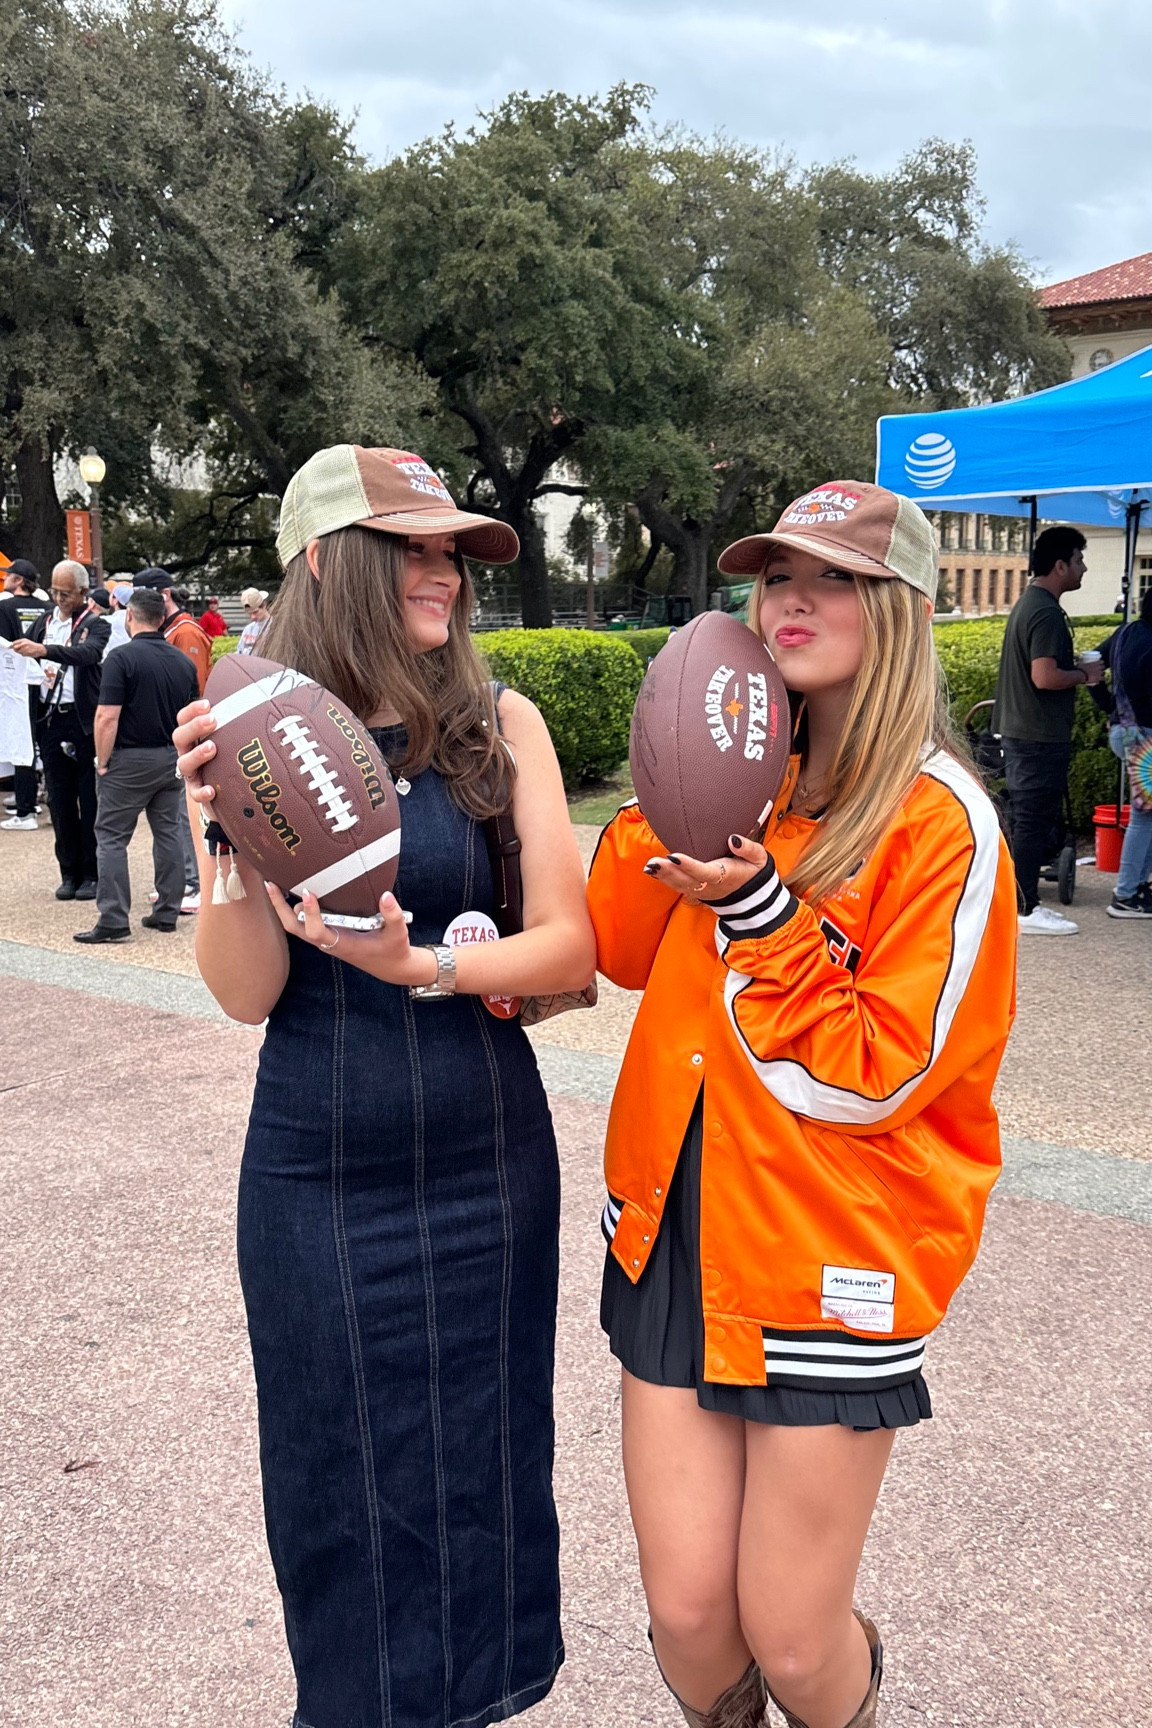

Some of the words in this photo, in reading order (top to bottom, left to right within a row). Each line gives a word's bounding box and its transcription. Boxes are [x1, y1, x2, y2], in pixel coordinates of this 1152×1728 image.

[74, 527, 84, 559] TEXAS
[705, 664, 736, 752] TAKEOVER
[744, 672, 768, 761] TEXAS
[237, 737, 302, 850] Wilson
[325, 704, 387, 812] Wilson
[452, 926, 495, 945] TEXAS
[830, 1277, 881, 1288] McLaren
